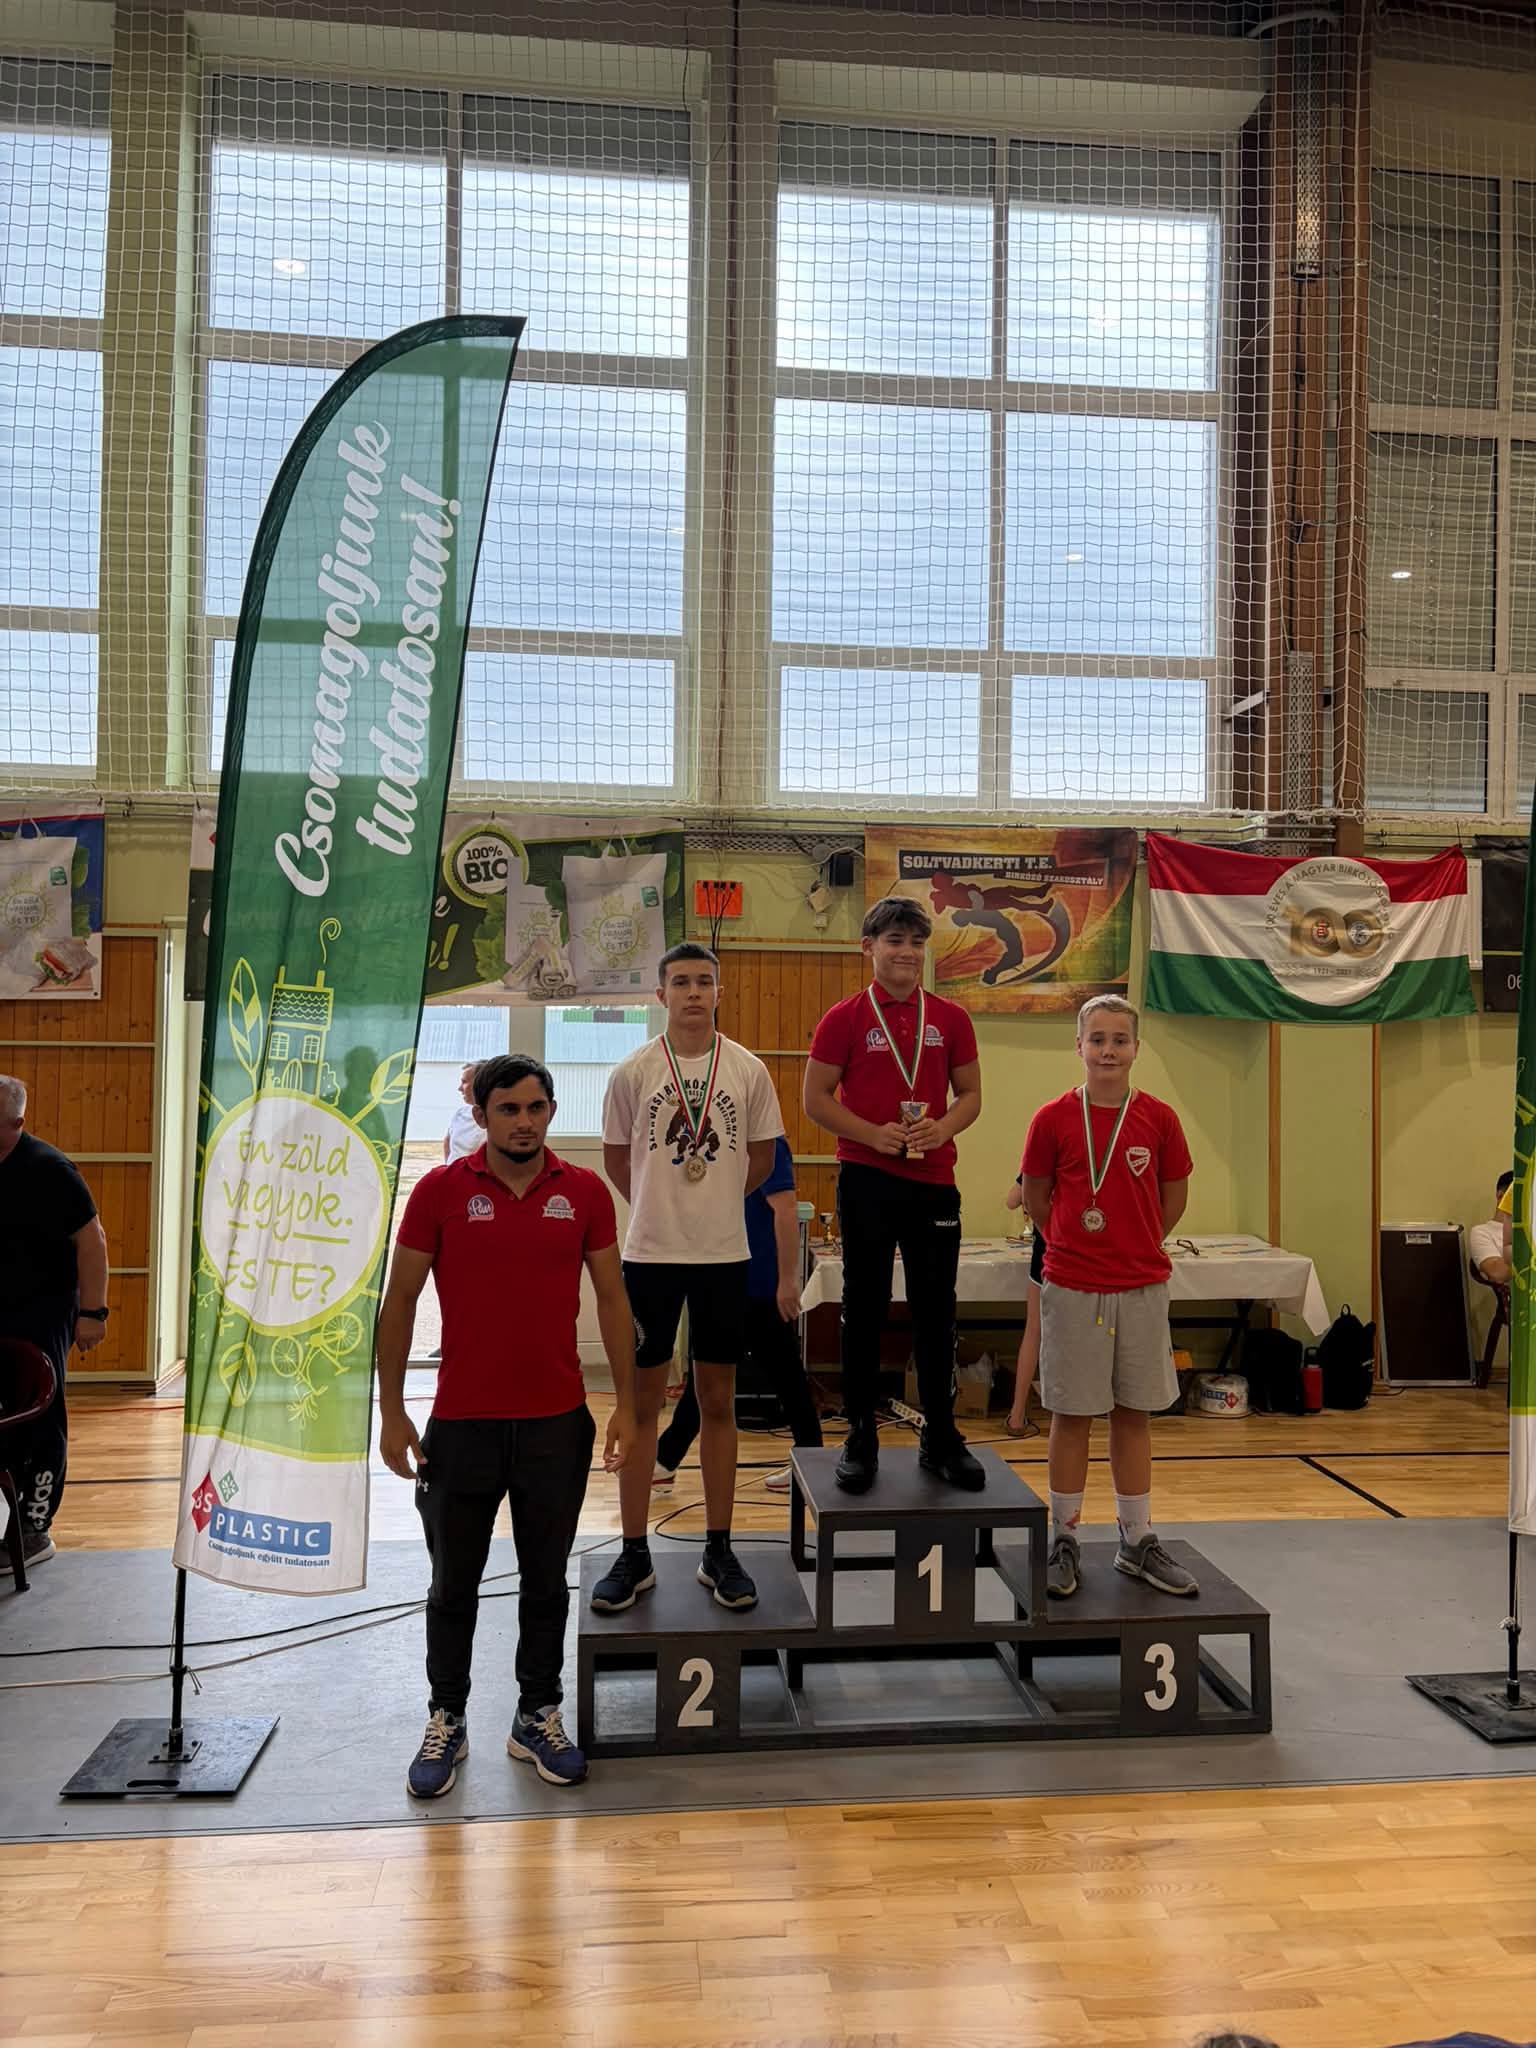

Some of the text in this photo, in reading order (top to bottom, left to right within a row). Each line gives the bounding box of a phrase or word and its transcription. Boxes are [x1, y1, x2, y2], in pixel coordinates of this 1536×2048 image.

[274, 420, 391, 897] Csomagoljunk
[355, 474, 461, 857] tudatosan!
[464, 858, 508, 884] BIO
[465, 845, 503, 861] 100%
[903, 855, 1053, 870] SOLTVADKERTI T.E.
[1293, 863, 1336, 882] MAGYAR
[281, 1134, 351, 1176] zöld
[215, 1512, 321, 1548] PLASTIC
[917, 1544, 943, 1612] 1
[677, 1657, 715, 1728] 2
[1143, 1642, 1178, 1712] 3
